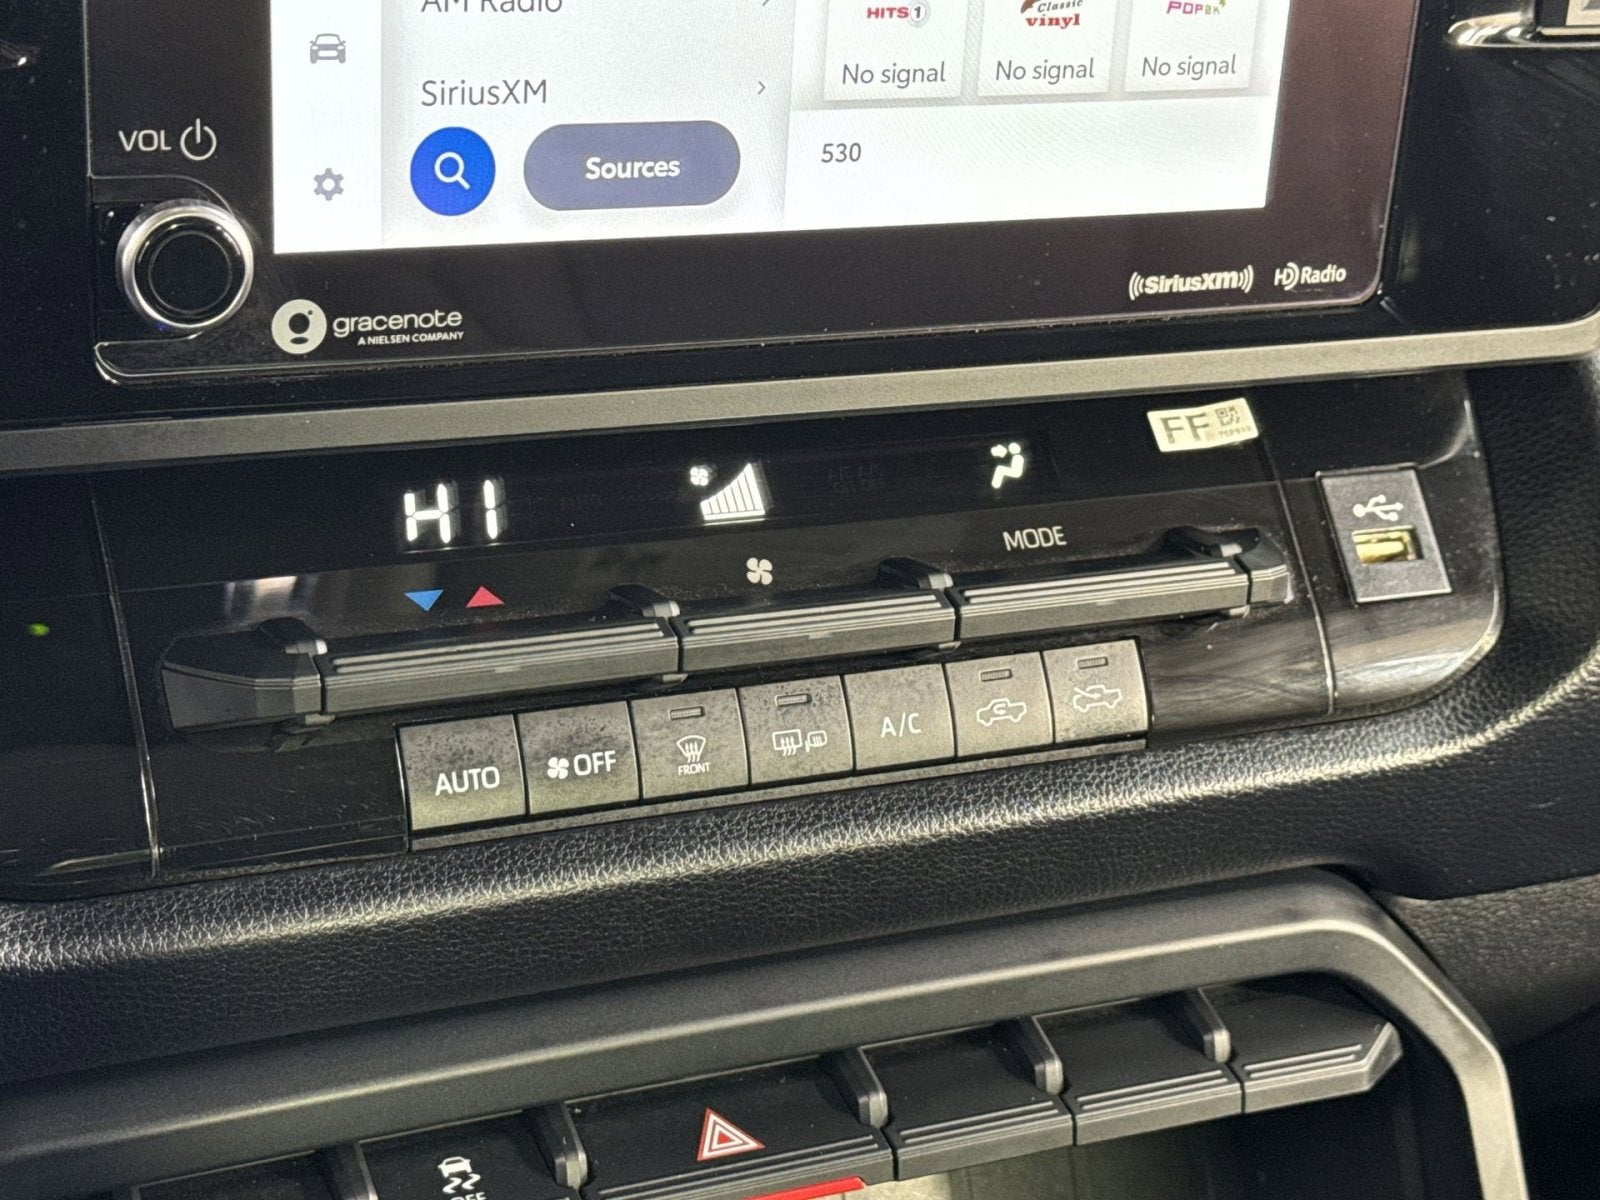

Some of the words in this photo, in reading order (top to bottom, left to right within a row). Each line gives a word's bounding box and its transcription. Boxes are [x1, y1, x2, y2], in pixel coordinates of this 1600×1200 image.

[1025, 13, 1081, 30] vinyl
[842, 64, 875, 85] No
[880, 61, 946, 89] signal
[995, 60, 1027, 81] No
[1032, 57, 1095, 85] signal
[1141, 56, 1172, 77] No
[1176, 53, 1236, 81] signal
[421, 79, 547, 107] SiriusXM
[118, 129, 172, 152] VOL
[820, 142, 862, 164] 530
[585, 156, 681, 180] Sources
[1301, 263, 1347, 285] Radio
[332, 309, 463, 338] gracenote
[357, 336, 366, 346] A
[367, 334, 411, 345] NIELSEN
[411, 331, 465, 343] COMPANY
[1160, 412, 1209, 444] FF
[1002, 525, 1067, 551] MODE
[880, 712, 922, 739] A/C
[573, 750, 617, 776] OFF
[677, 761, 711, 776] FRONT
[435, 765, 501, 796] AUTO
